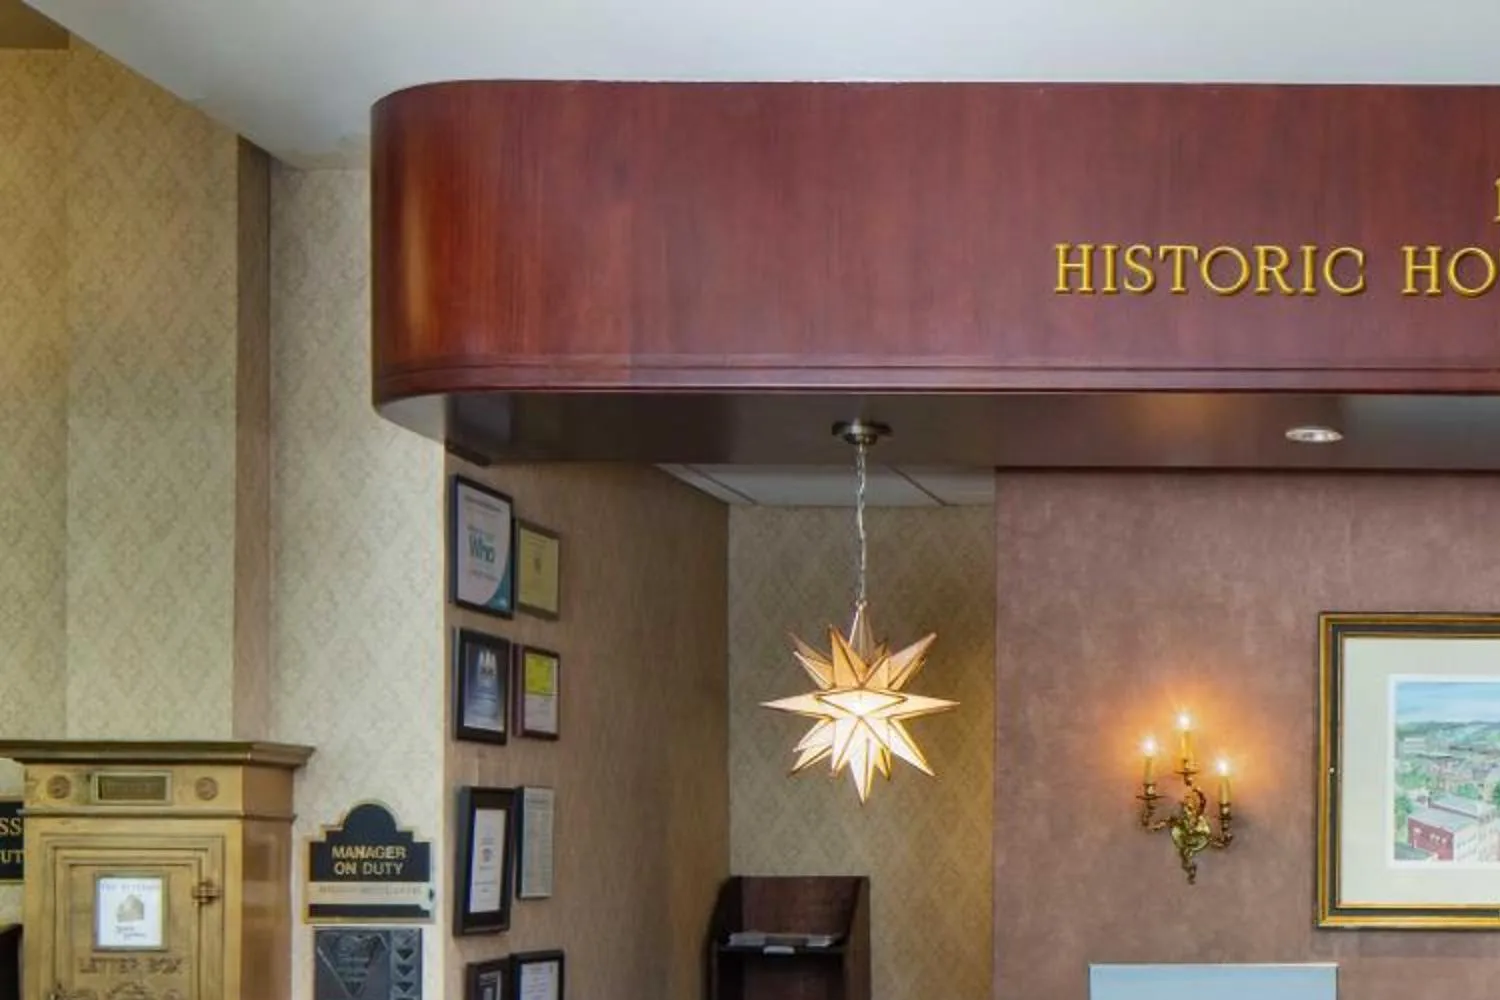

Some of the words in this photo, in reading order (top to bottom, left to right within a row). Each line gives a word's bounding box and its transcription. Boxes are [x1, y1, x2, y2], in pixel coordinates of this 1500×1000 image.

[1053, 243, 1367, 296] HISTORIC
[331, 845, 407, 859] MANAGER
[334, 861, 356, 875] ON
[362, 861, 404, 875] DUTY
